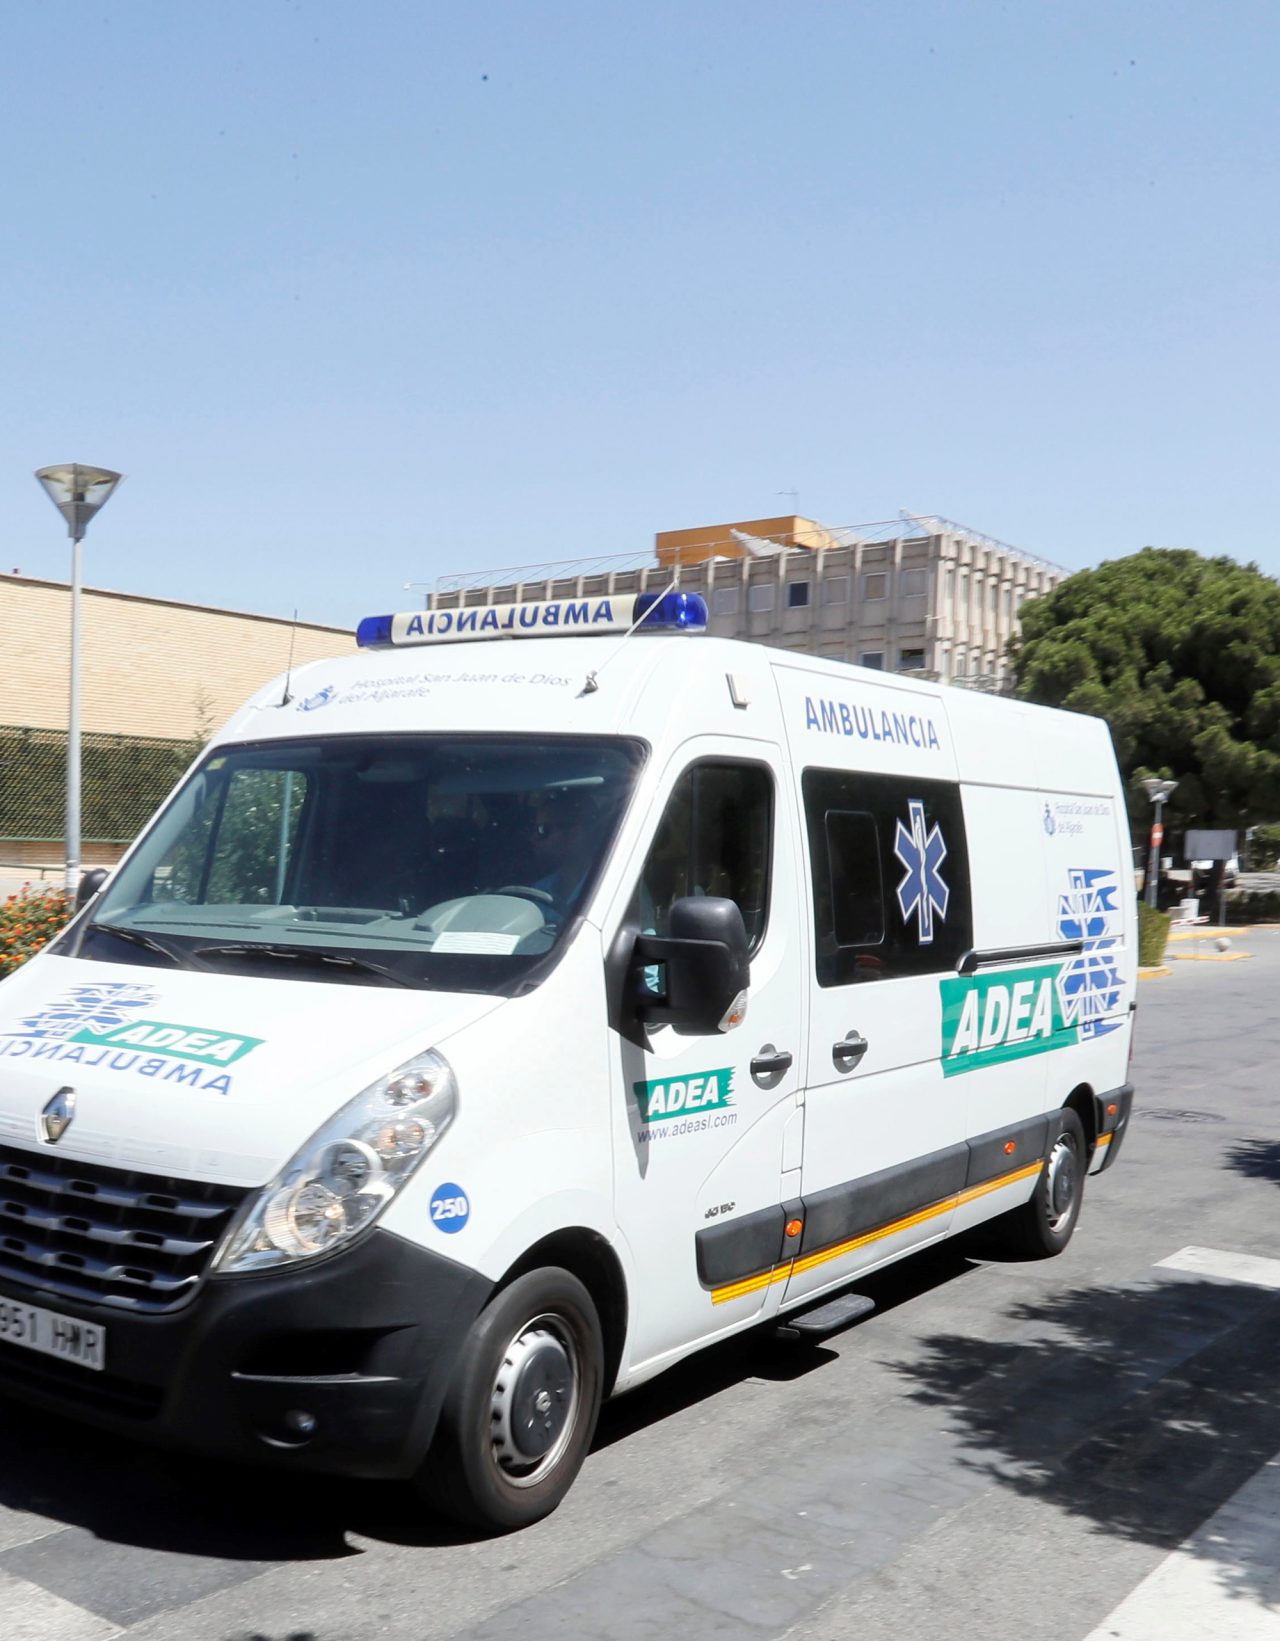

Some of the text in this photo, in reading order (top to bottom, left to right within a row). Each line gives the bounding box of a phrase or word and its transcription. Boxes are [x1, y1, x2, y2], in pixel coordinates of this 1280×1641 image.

[352, 672, 572, 690] Hospital San Juan de Dios
[805, 696, 940, 750] AMBULANCIA
[947, 978, 1052, 1059] ADEA
[106, 1024, 245, 1061] ADEA
[647, 1076, 719, 1116] ADEA
[638, 1112, 738, 1143] www.adeasl.com
[431, 1196, 468, 1221] 250
